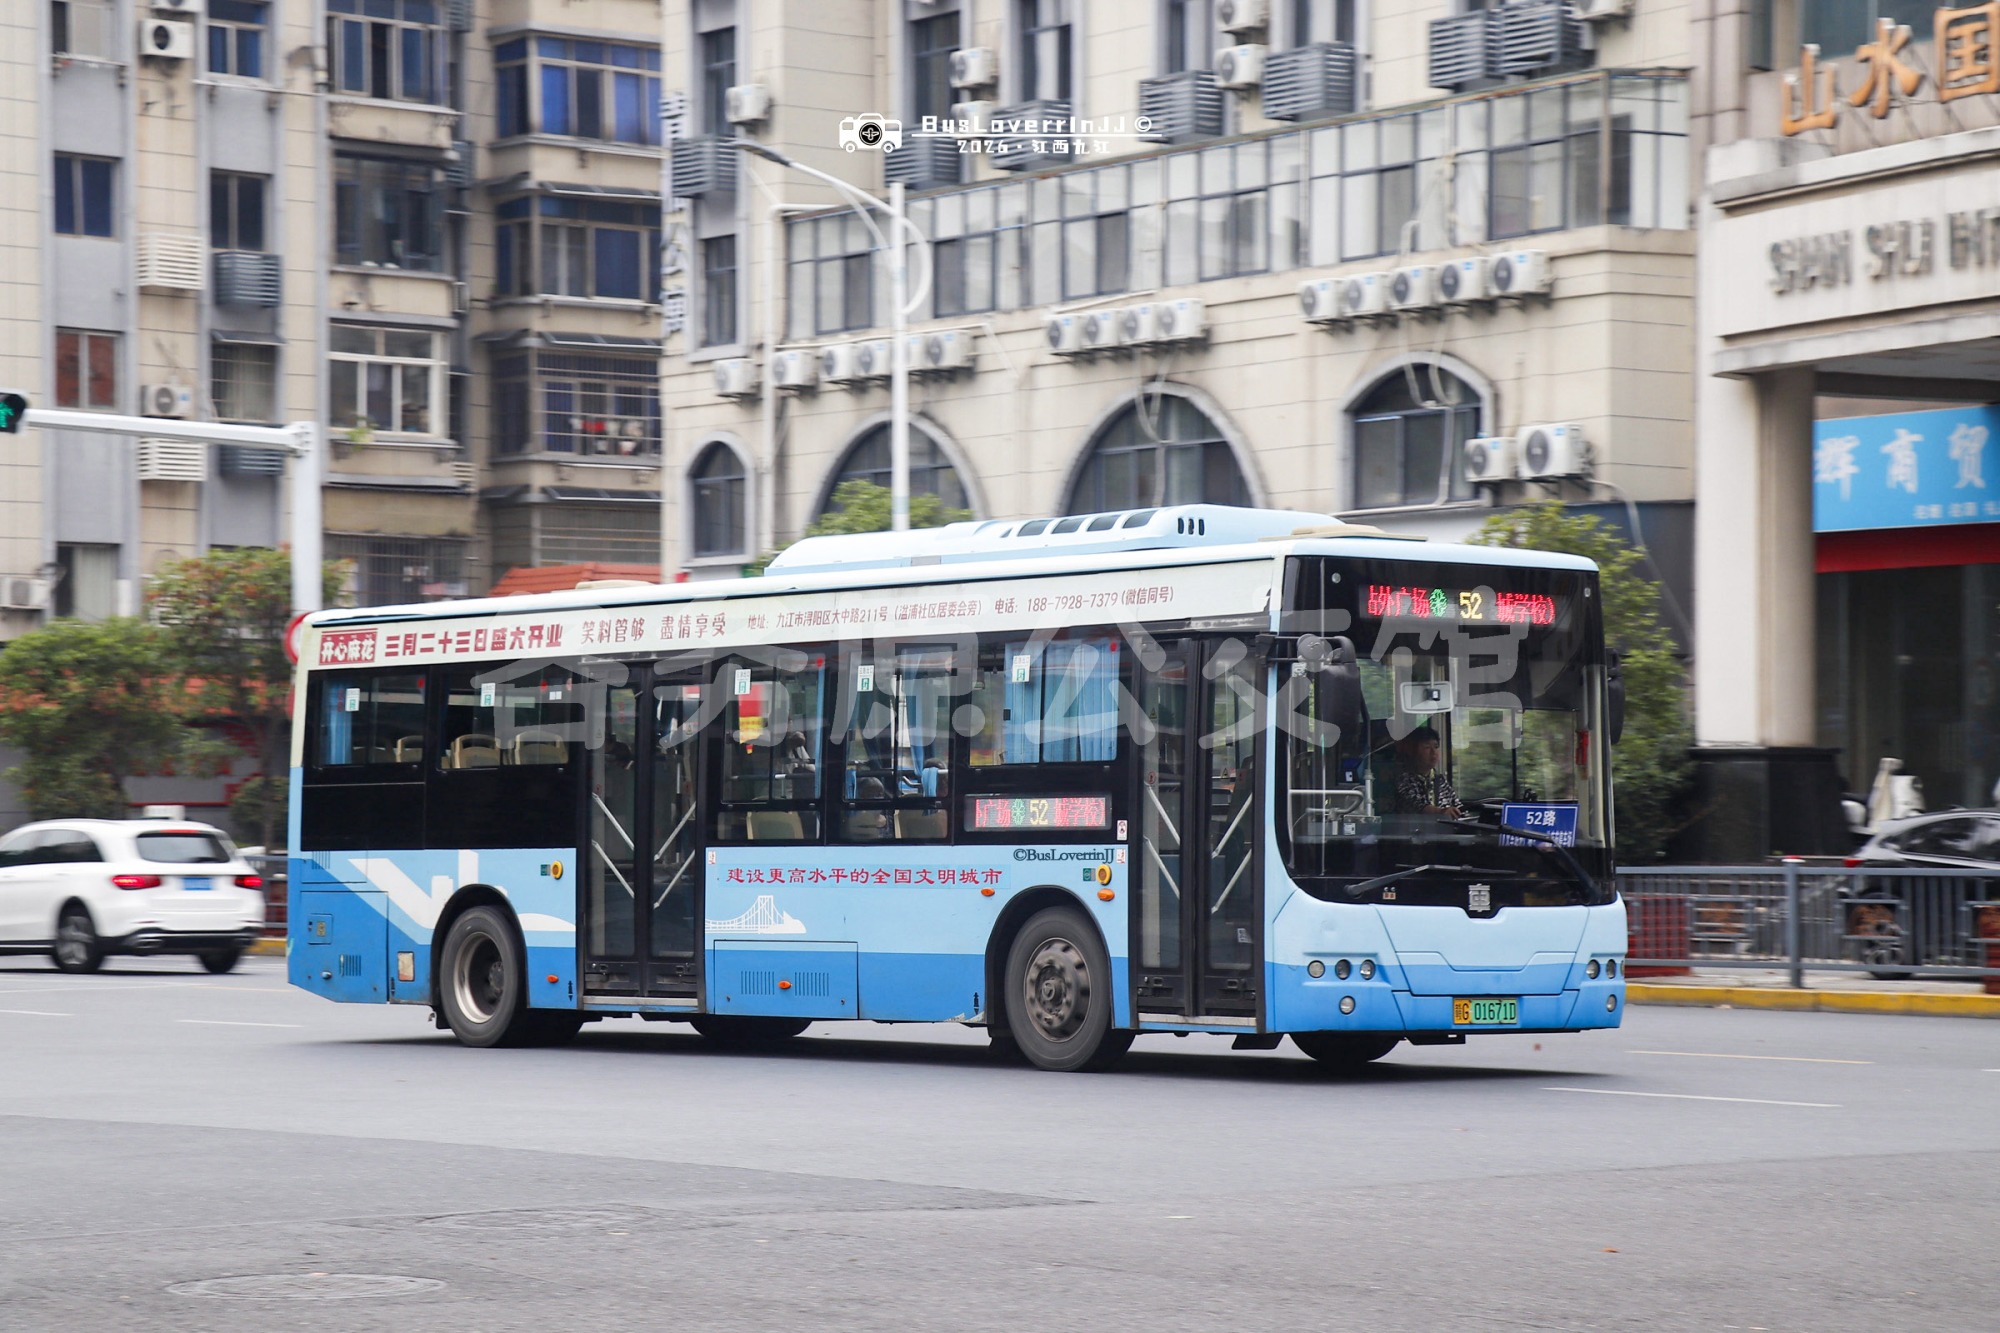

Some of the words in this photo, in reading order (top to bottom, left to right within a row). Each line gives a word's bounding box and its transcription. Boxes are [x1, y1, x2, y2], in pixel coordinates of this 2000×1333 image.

[1782, 0, 2000, 136] 山水国
[1459, 592, 1483, 619] 52
[385, 624, 563, 657] 三月二十三日盛大开业
[581, 617, 646, 645] 笑料管够
[1029, 799, 1049, 826] 52
[1526, 810, 1556, 827] 52路
[725, 867, 1004, 886] 建设更高水平的全国文明城市
